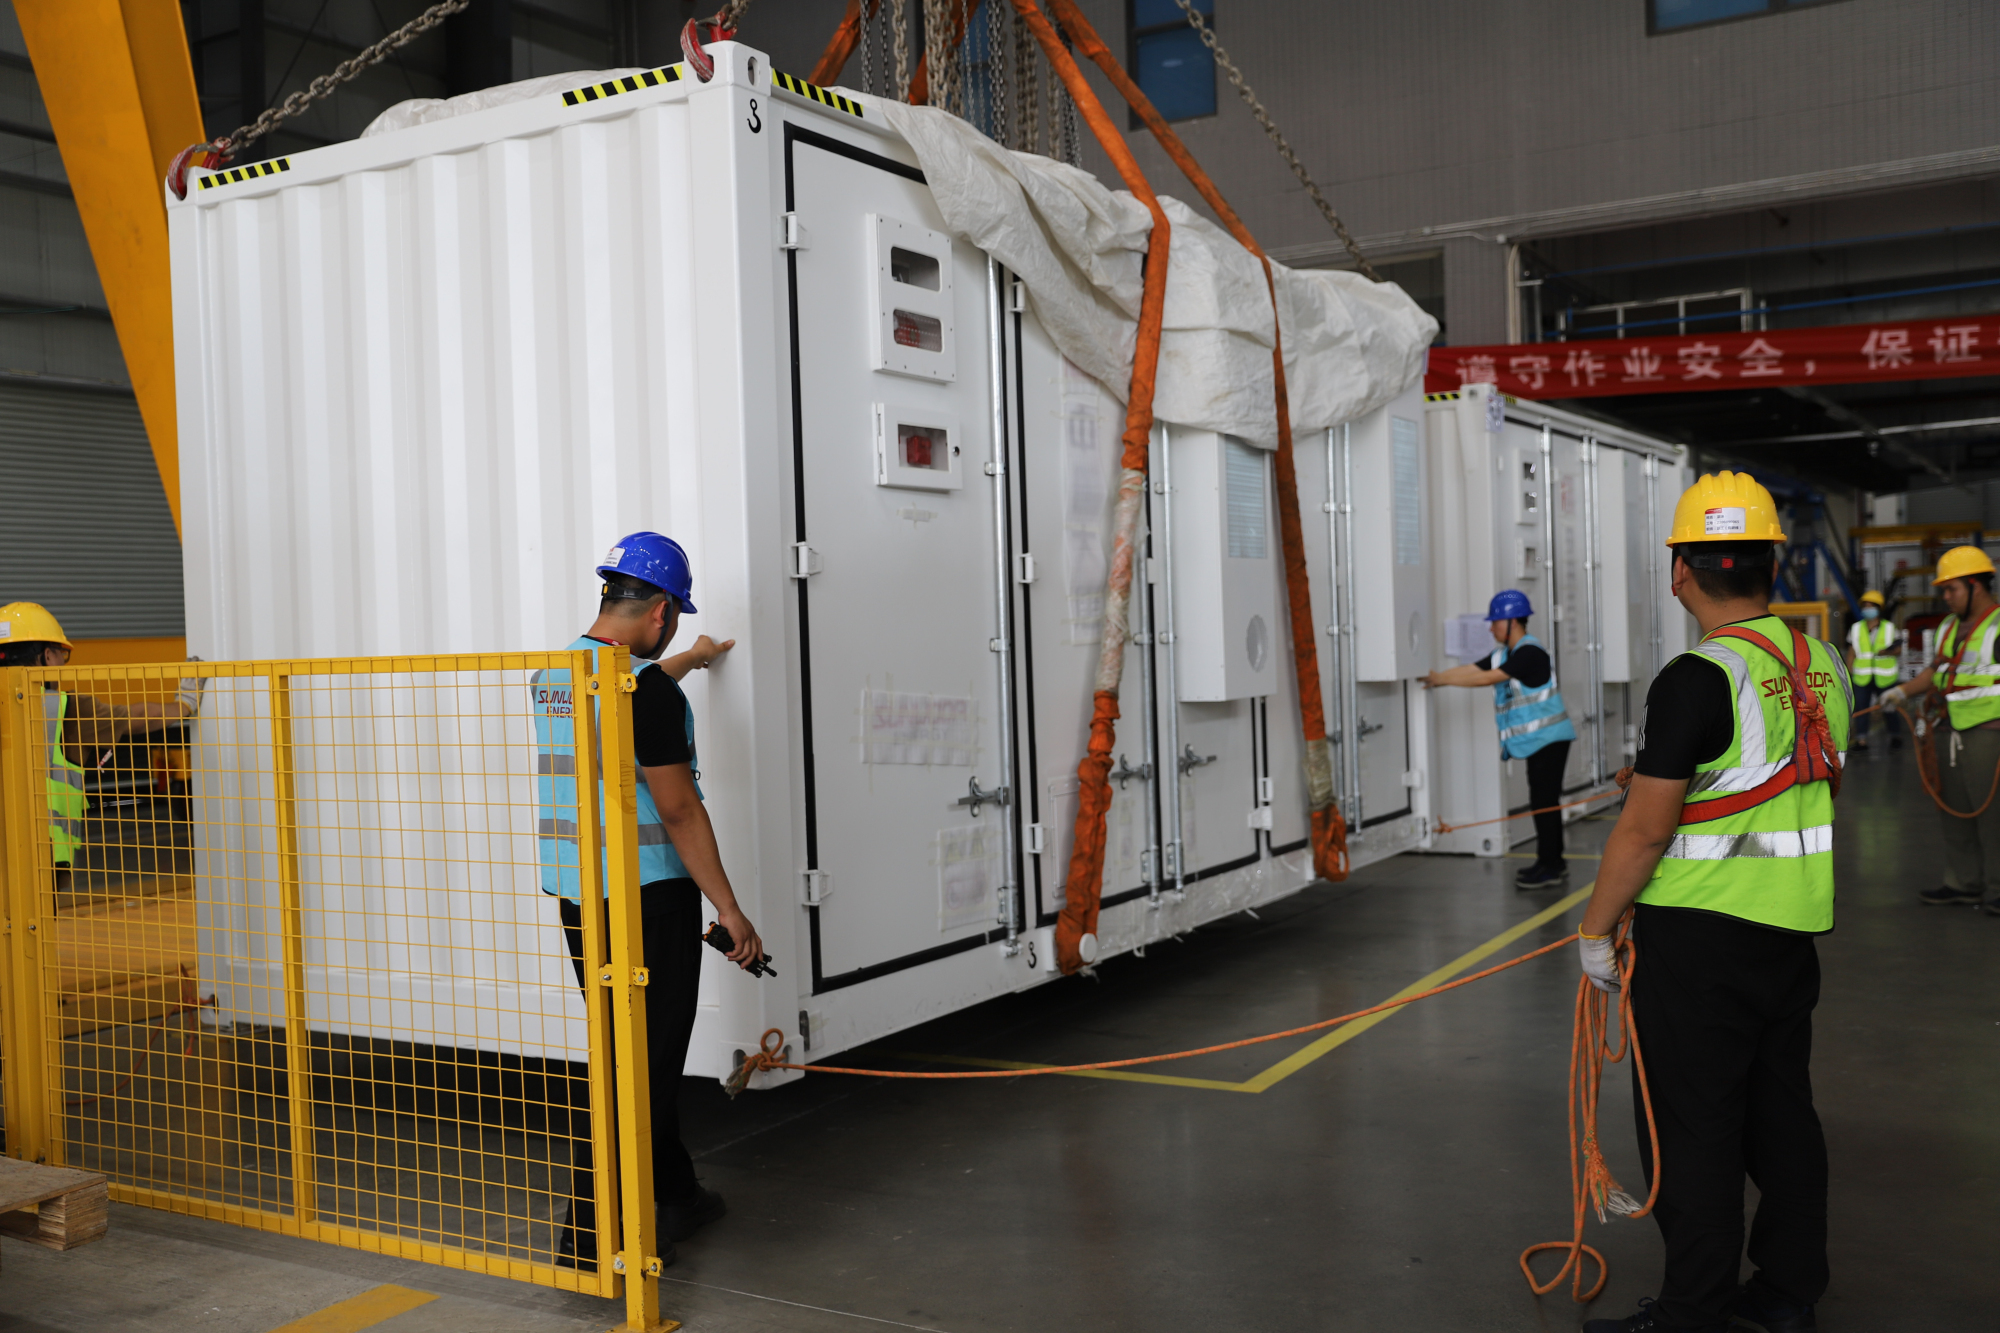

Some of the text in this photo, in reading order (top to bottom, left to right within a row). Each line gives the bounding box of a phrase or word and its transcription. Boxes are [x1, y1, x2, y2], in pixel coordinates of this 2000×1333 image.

[1455, 324, 2000, 391] 遵守作业安全，保证
[1761, 671, 1836, 698] SUNODA
[546, 705, 574, 719] ENER
